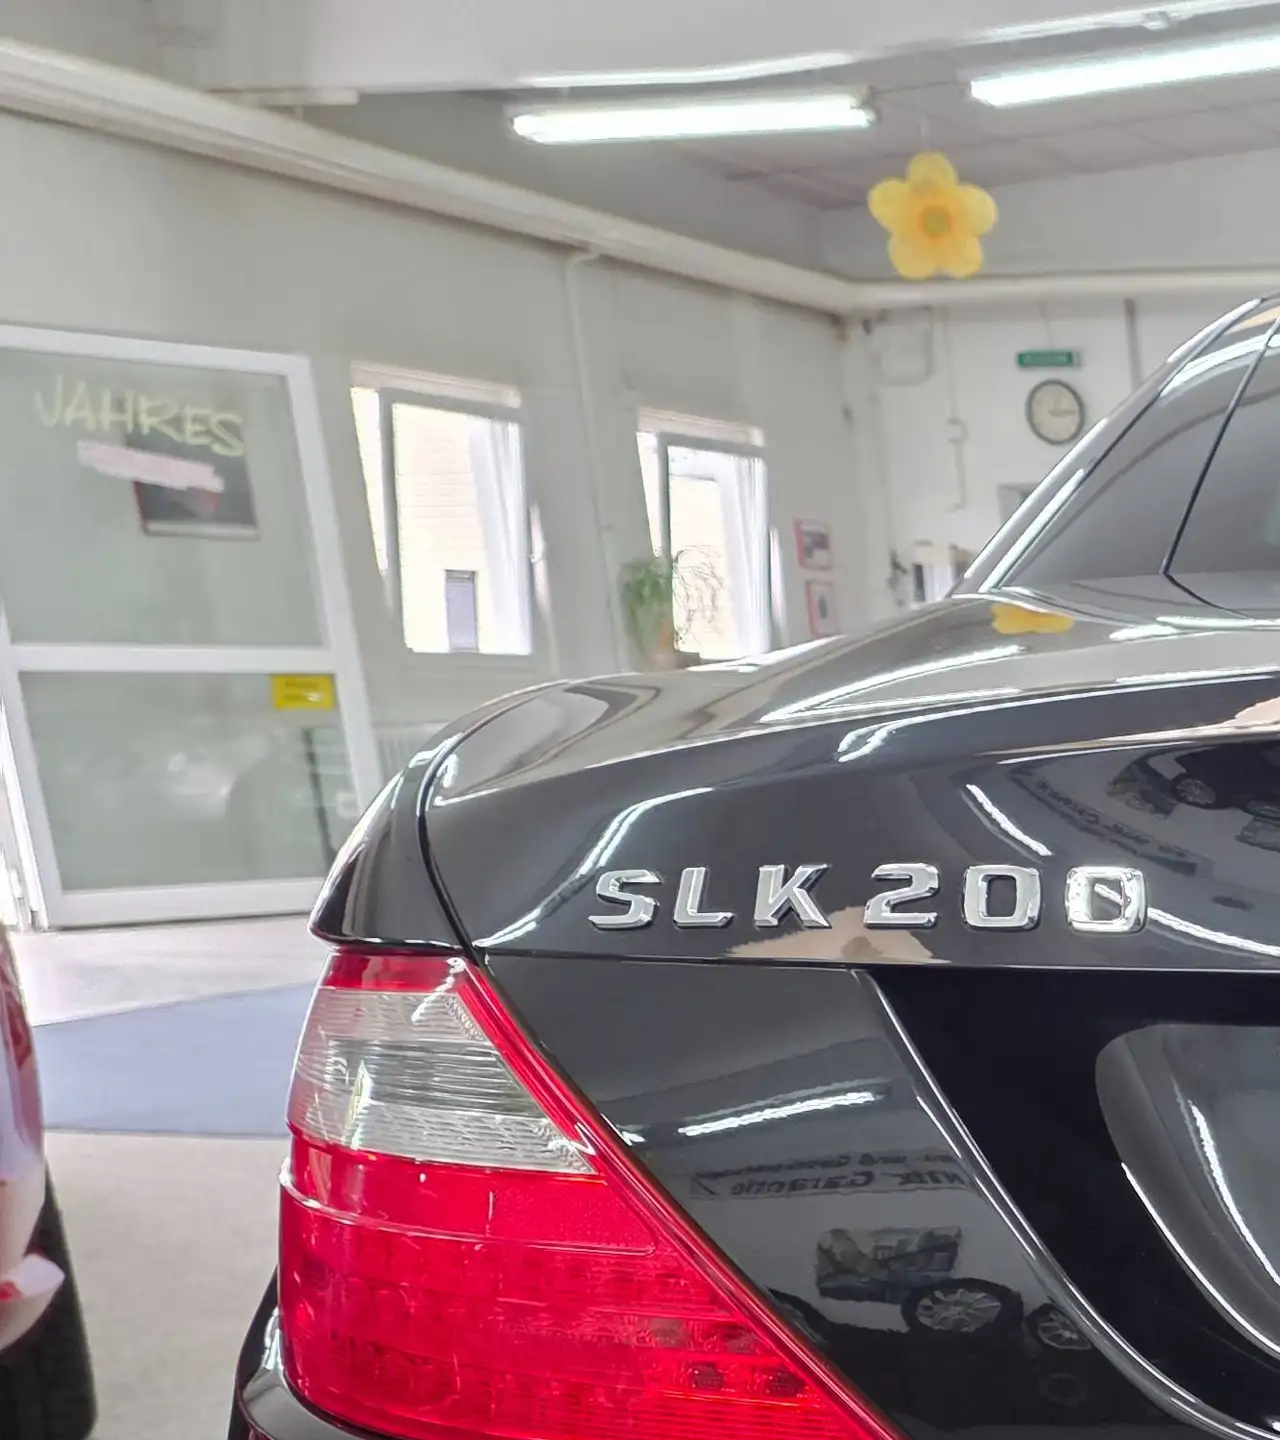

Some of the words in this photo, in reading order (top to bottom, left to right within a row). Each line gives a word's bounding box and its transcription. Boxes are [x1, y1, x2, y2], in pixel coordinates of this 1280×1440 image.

[34, 374, 244, 457] JAHRES
[588, 863, 832, 929] SLK
[862, 862, 1148, 932] 200
